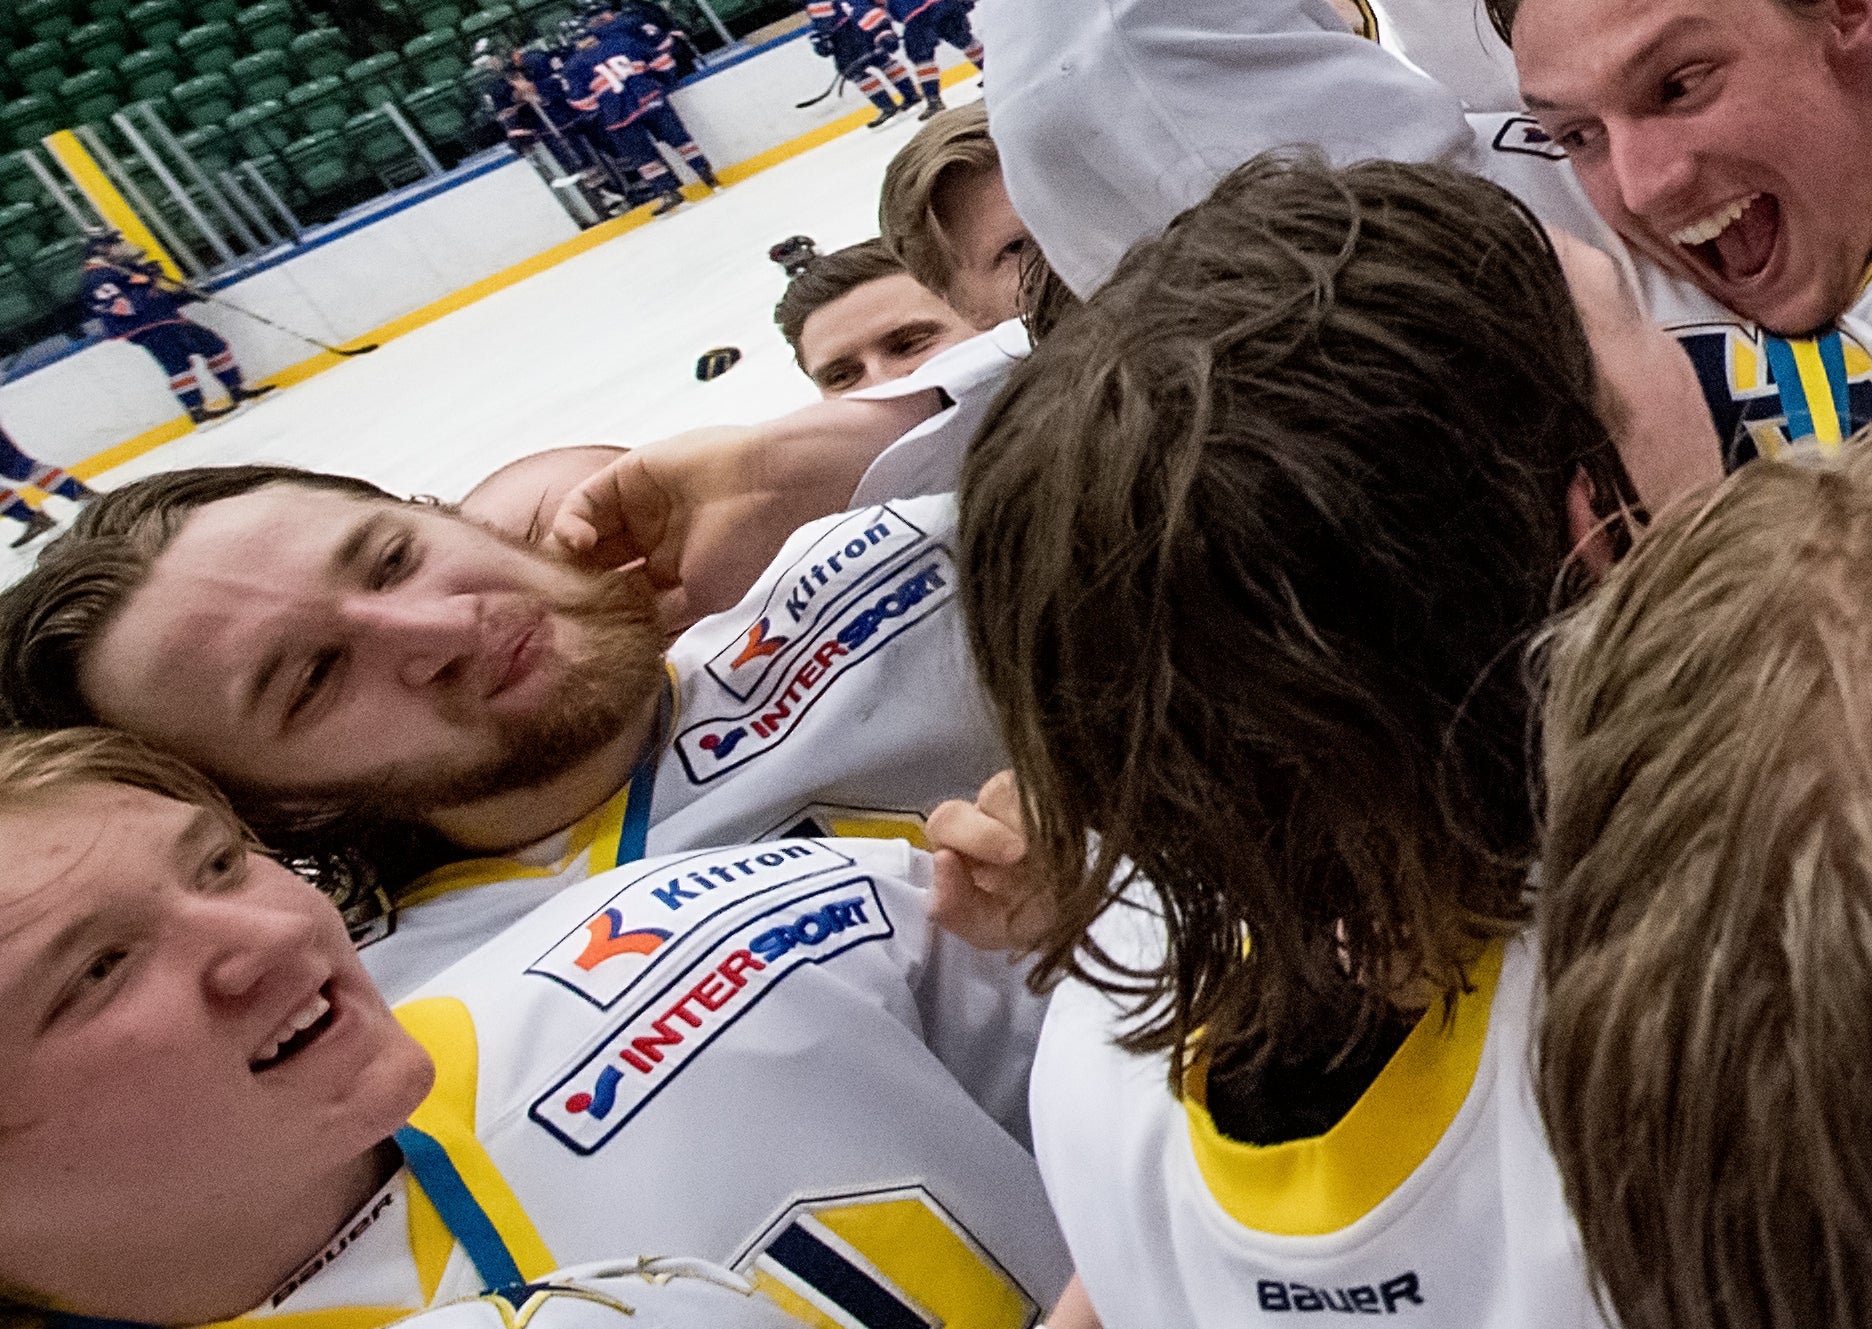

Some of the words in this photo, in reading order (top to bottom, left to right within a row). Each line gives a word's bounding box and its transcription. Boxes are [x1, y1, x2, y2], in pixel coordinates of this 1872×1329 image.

[785, 522, 891, 623] Kitron
[750, 562, 947, 739] INTERSPORT
[651, 844, 815, 911] Kitron
[619, 895, 870, 1074] INTERSPORT
